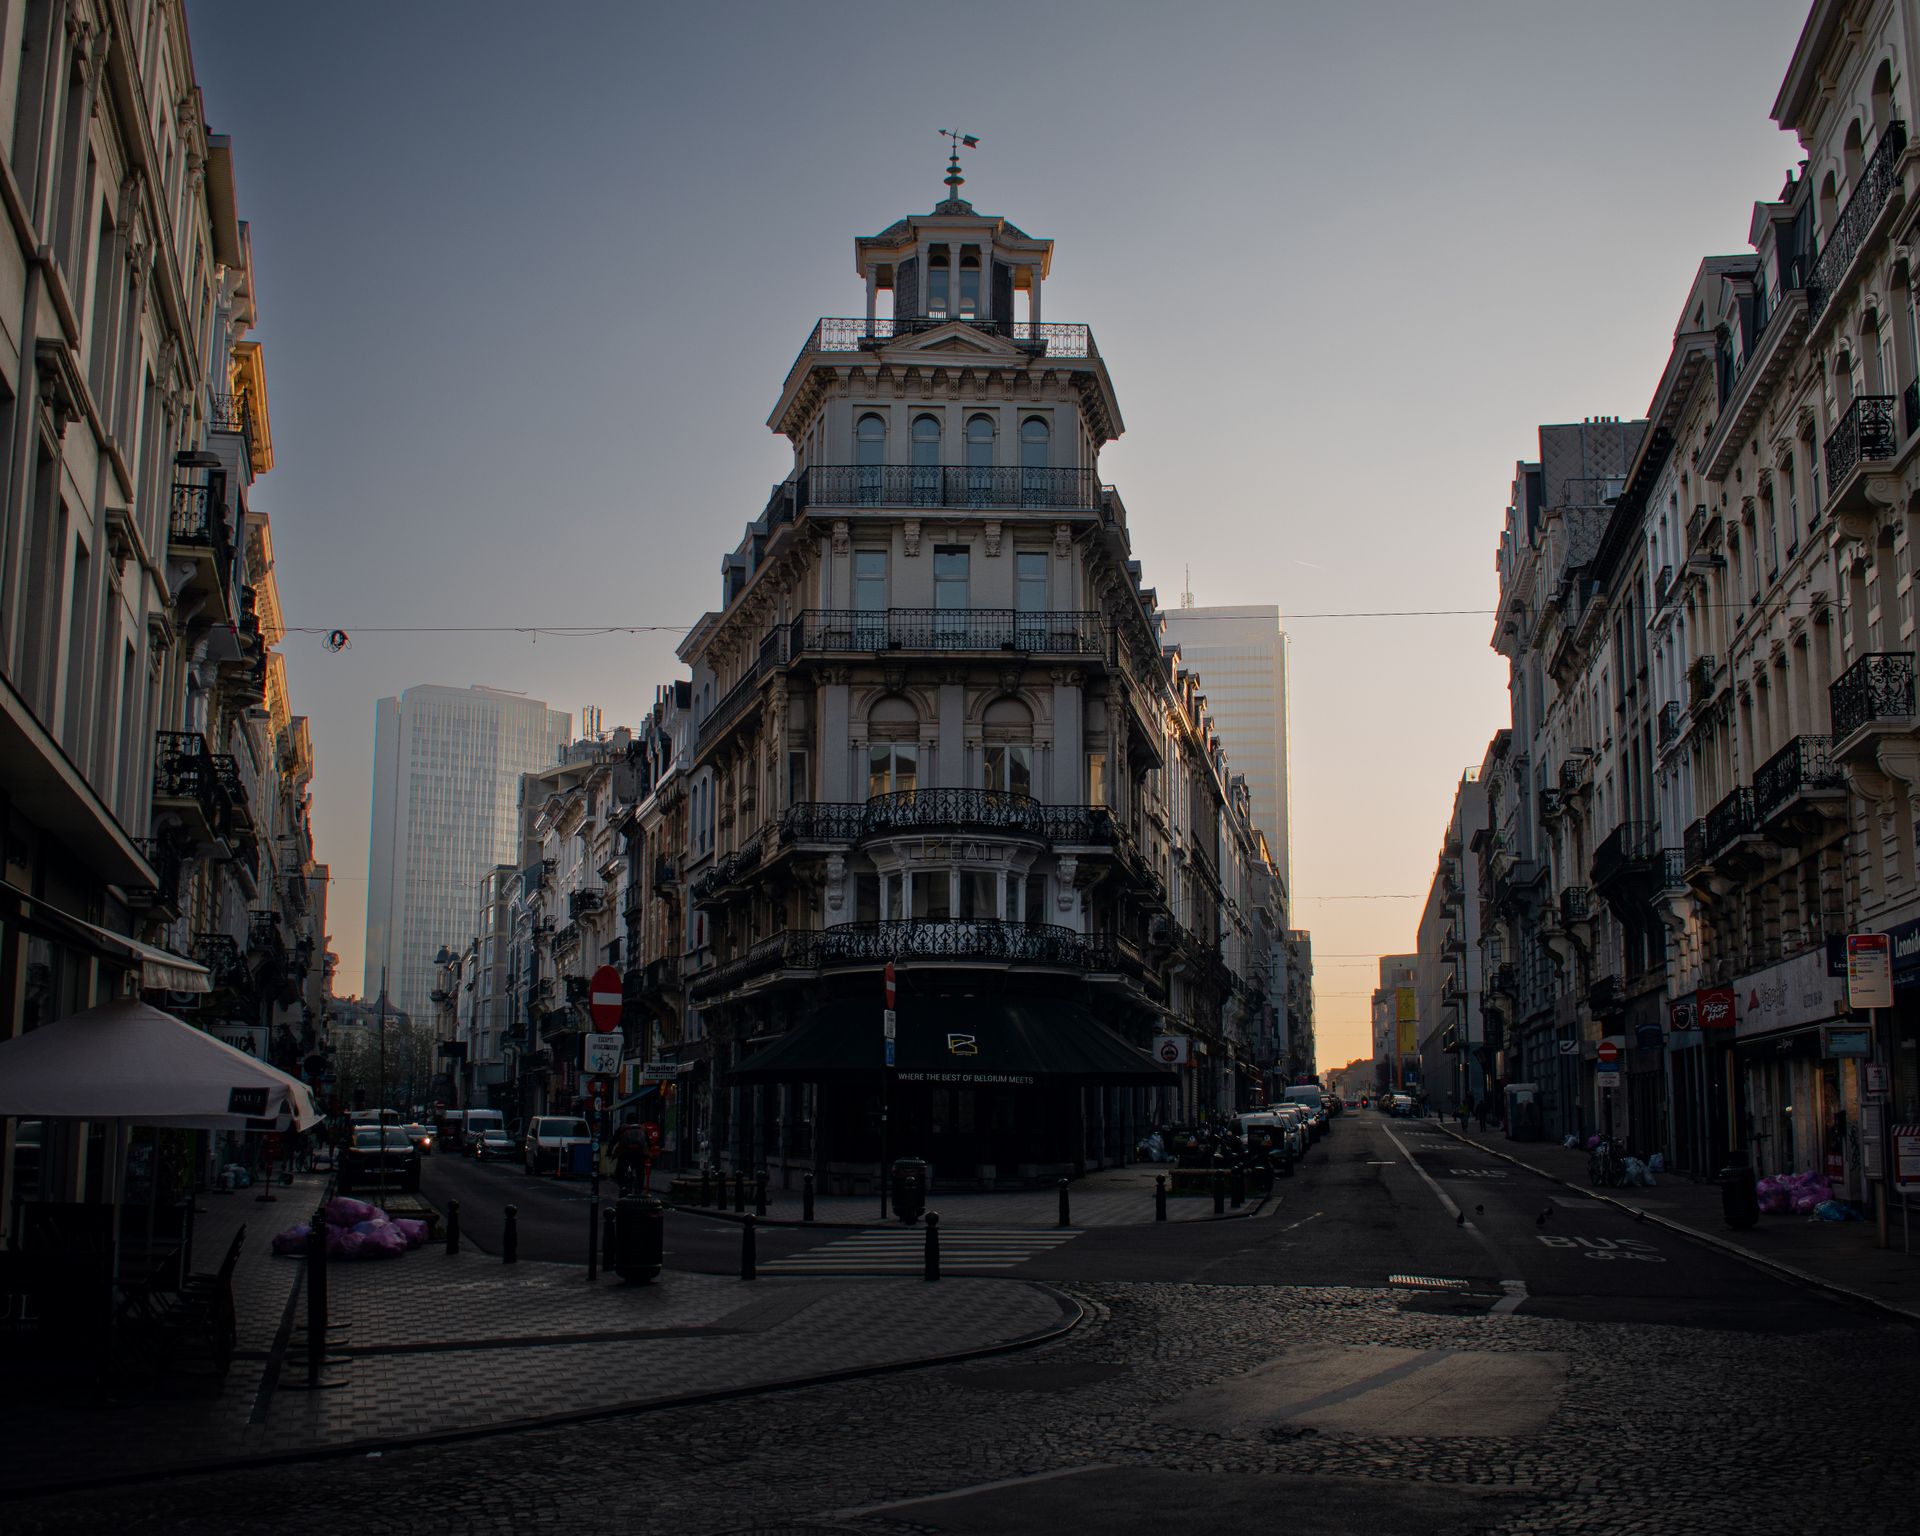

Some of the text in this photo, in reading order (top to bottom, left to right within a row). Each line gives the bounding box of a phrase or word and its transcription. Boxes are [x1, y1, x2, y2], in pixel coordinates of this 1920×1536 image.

[1894, 928, 1920, 958] Leonid
[1702, 1004, 1729, 1016] Pizza
[1707, 1012, 1728, 1022] Hut
[898, 1073, 1034, 1084] WHERE THE BEST OF BELGIUM MEETS
[1536, 1236, 1660, 1251] BUS
